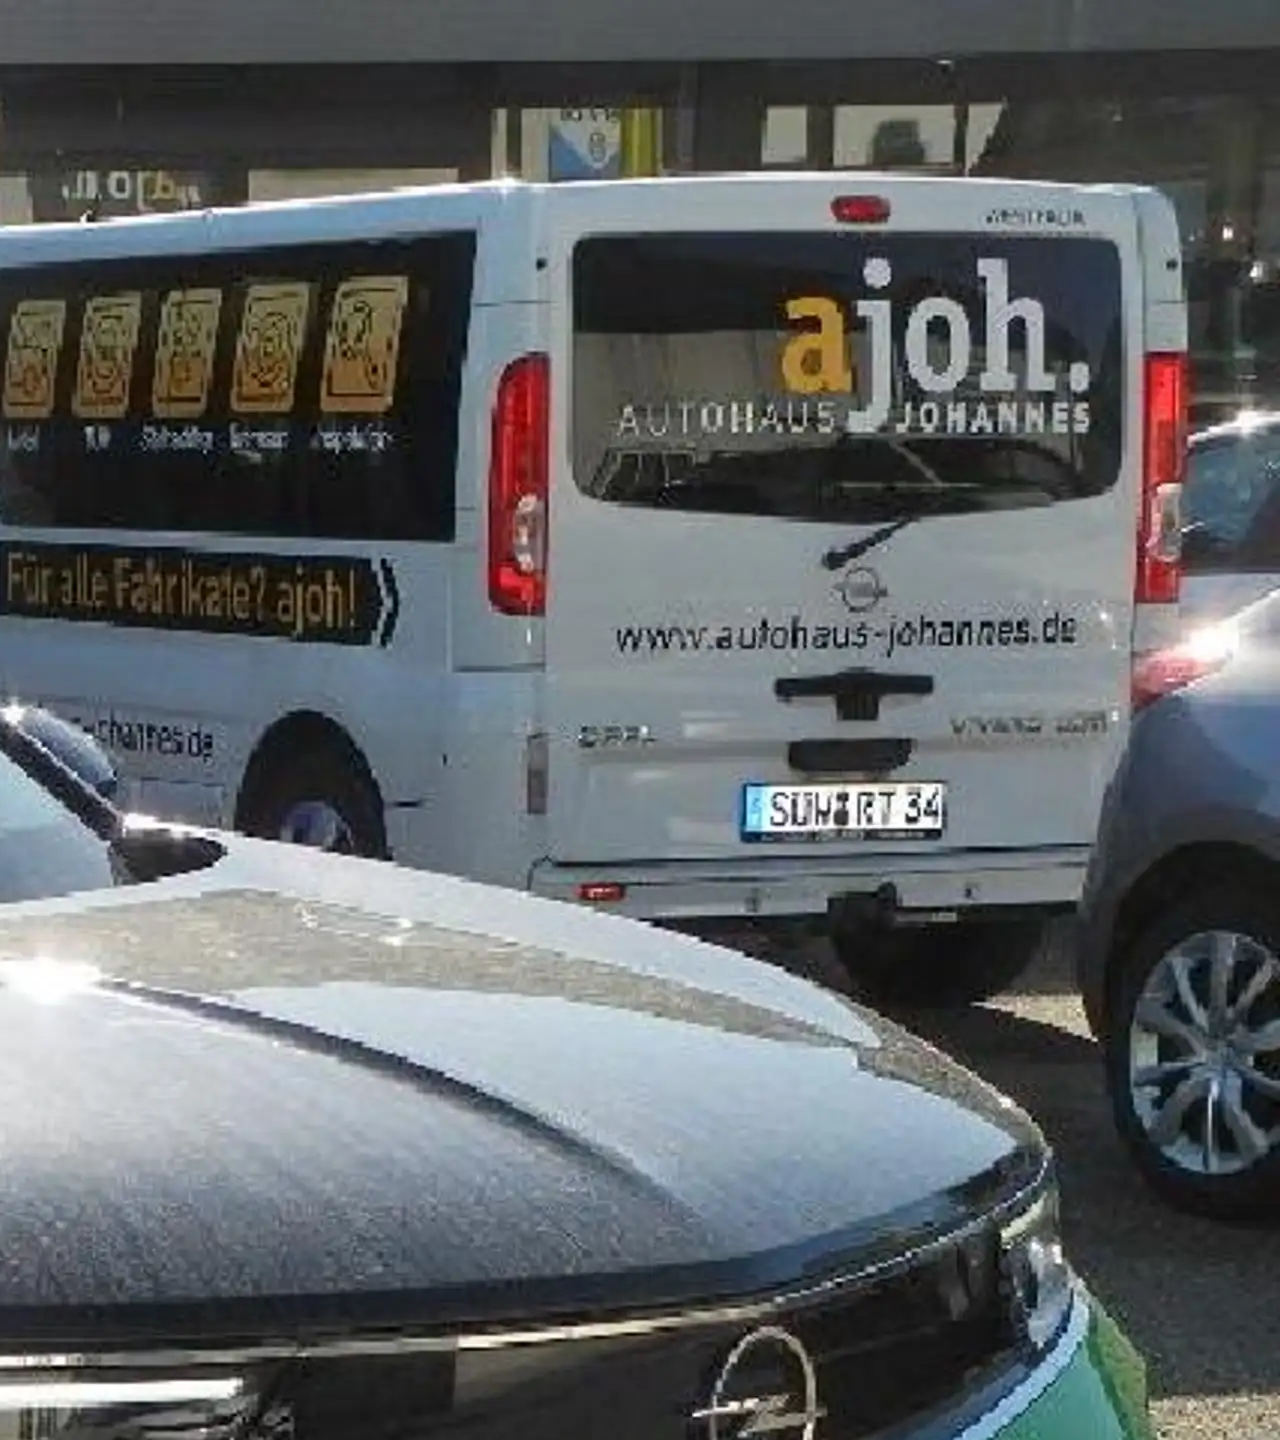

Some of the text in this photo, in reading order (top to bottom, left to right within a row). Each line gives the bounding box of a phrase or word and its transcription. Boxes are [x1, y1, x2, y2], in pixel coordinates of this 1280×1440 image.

[782, 257, 1091, 434] ajoh.
[617, 401, 1091, 437] AUTOHAUS JOHANNES
[7, 551, 355, 636] Für alle Fabrikate? ajoh!
[617, 612, 1076, 658] www.autohaus-johannes.de
[904, 786, 939, 825] 34
